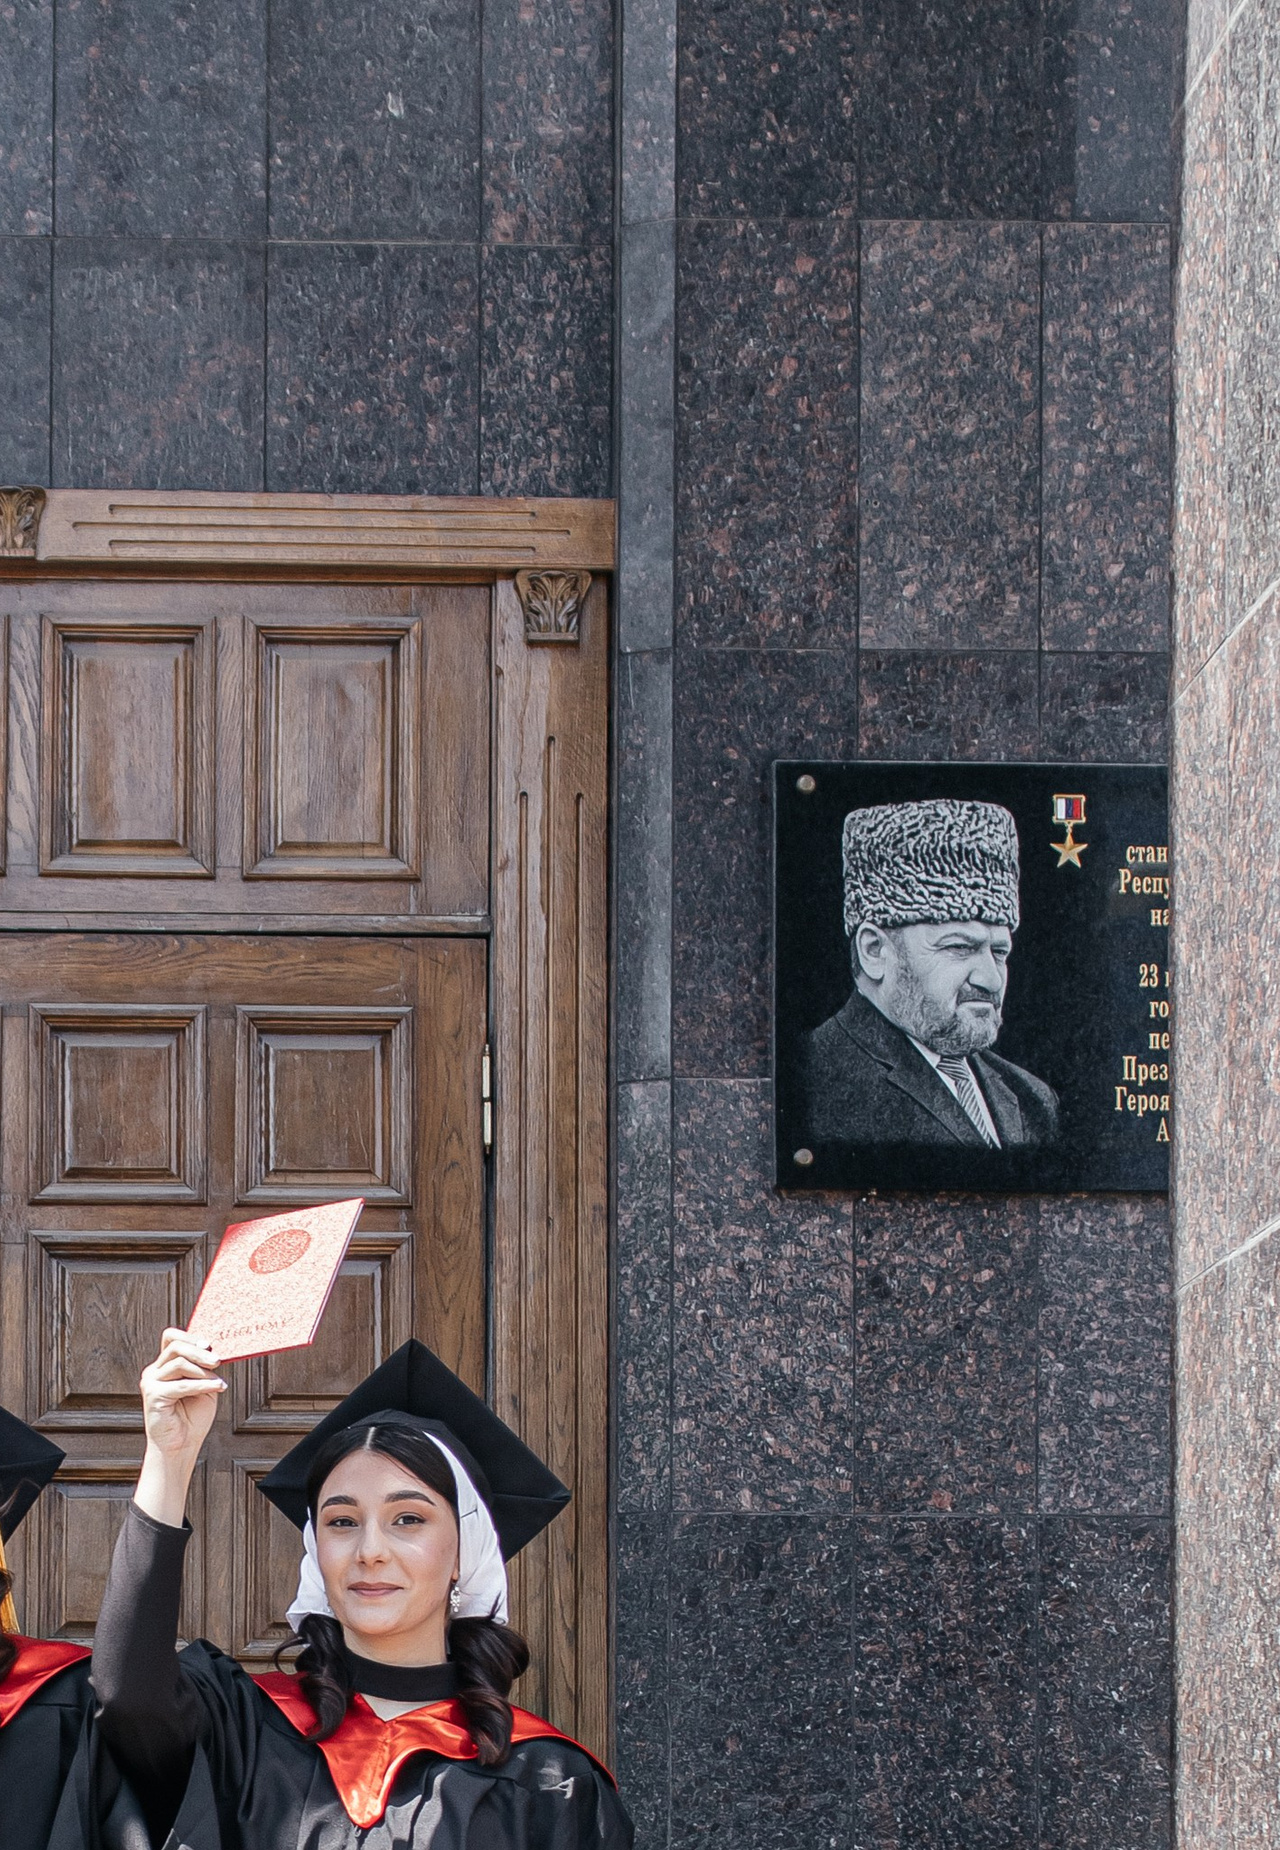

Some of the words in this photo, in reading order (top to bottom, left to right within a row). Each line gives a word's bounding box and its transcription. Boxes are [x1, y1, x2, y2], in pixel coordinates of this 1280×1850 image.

[1139, 963, 1159, 988] 23
[1149, 1001, 1170, 1018] го
[1122, 1055, 1169, 1087] През
[1114, 1086, 1170, 1117] Героя
